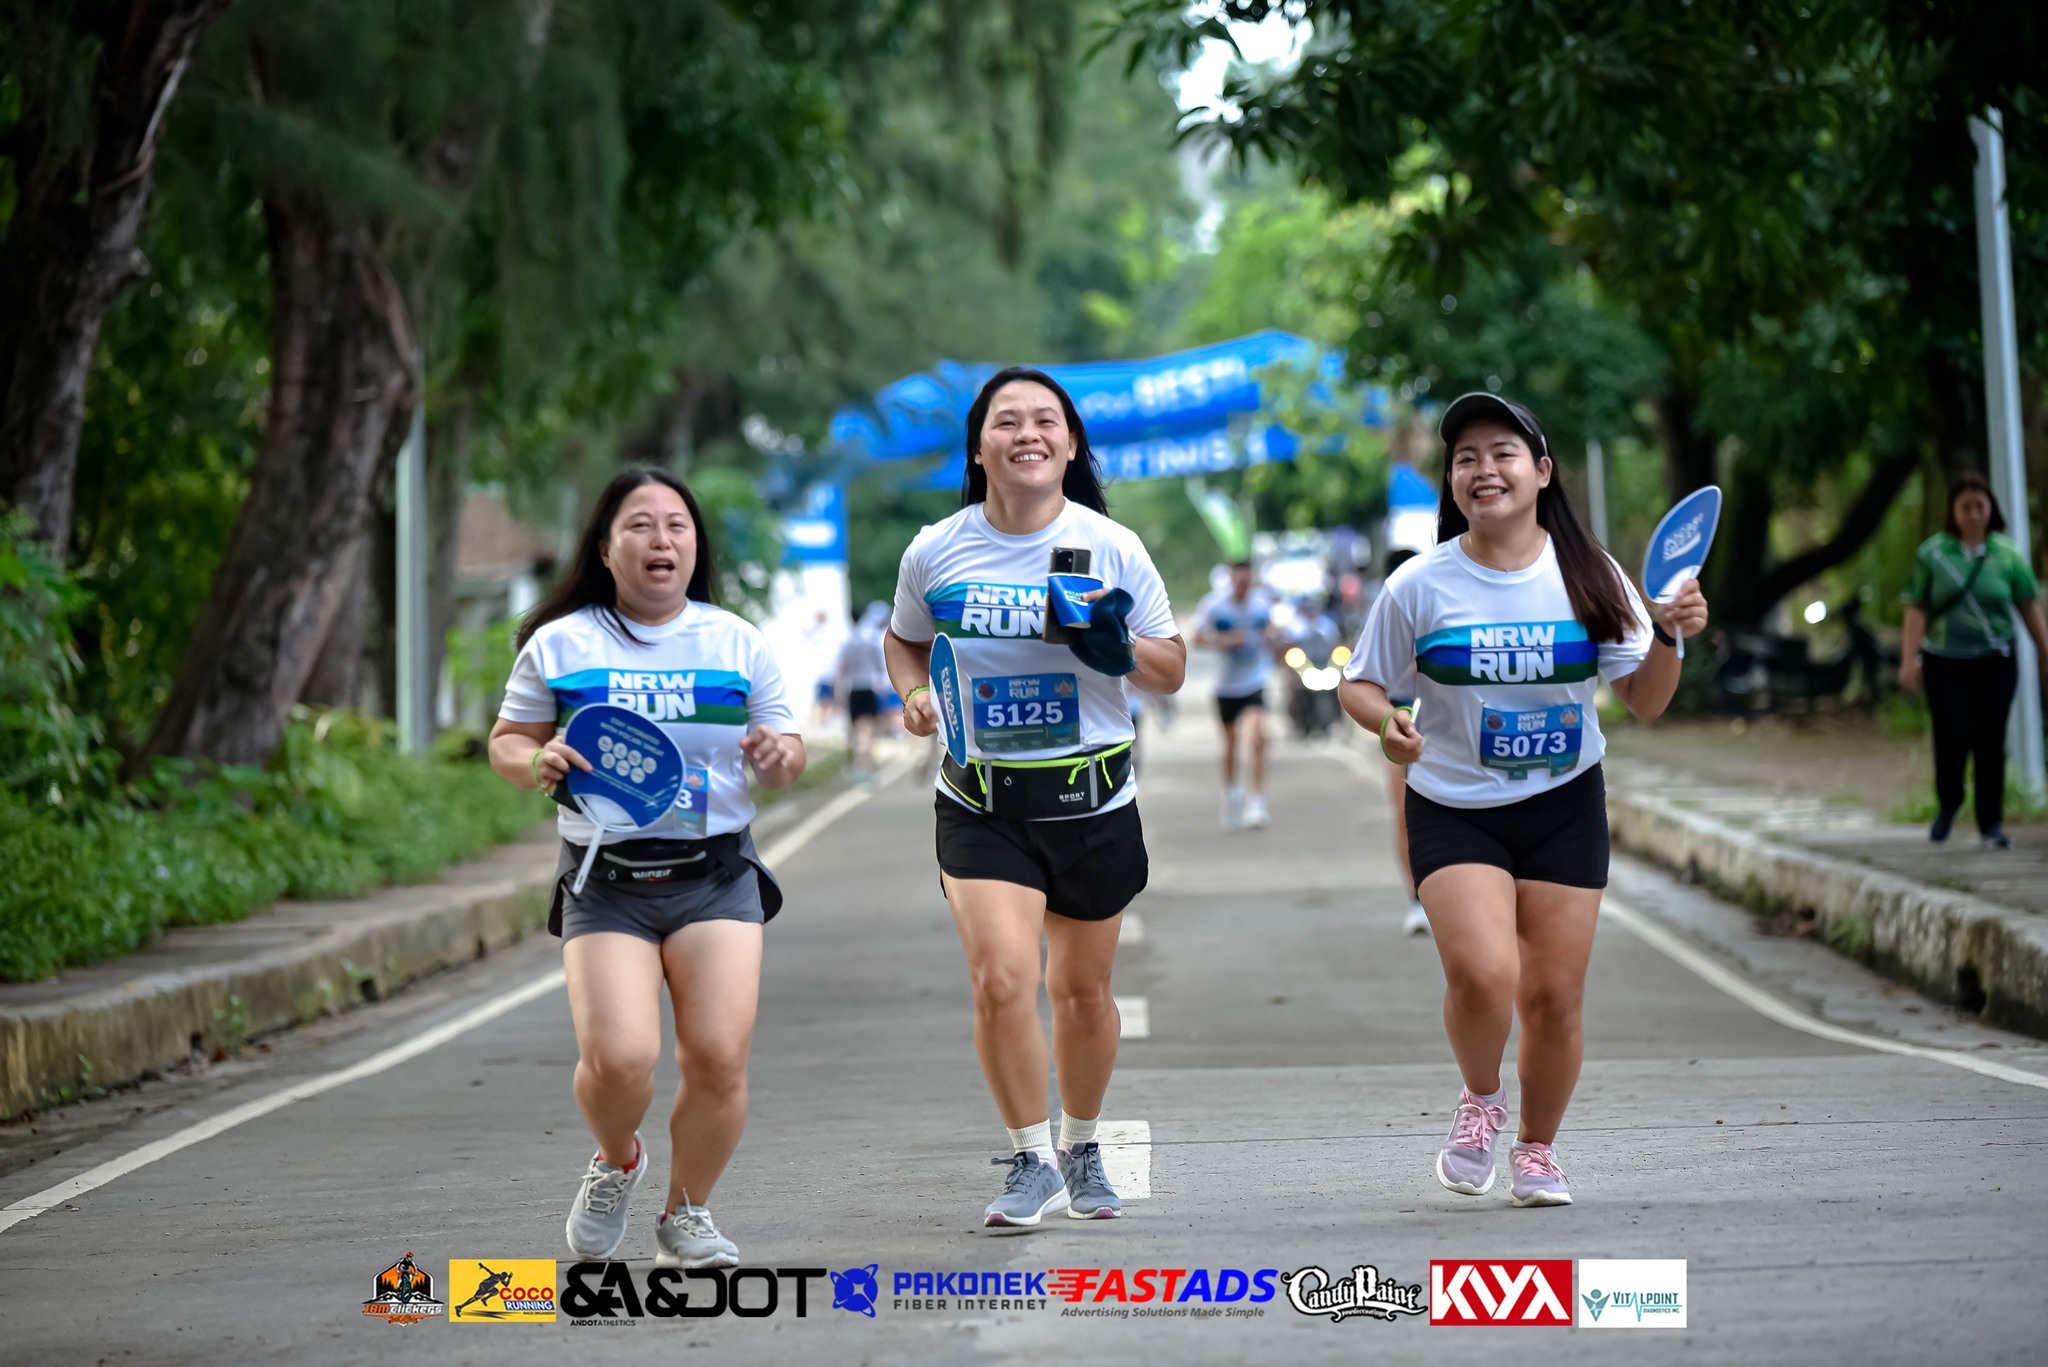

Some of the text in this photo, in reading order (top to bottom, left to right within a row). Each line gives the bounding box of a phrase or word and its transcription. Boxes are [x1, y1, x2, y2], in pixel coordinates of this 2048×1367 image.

[965, 584, 1048, 607] NRW
[960, 607, 1046, 637] RUN
[1471, 625, 1555, 647] NRW
[1470, 651, 1554, 683] RUN
[608, 671, 696, 689] NRW
[1008, 678, 1040, 687] NRW
[1009, 687, 1040, 699] RUN
[987, 701, 1063, 727] 5125
[1517, 719, 1546, 731] RUN
[1518, 711, 1548, 720] NRW
[1493, 731, 1567, 757] 5073
